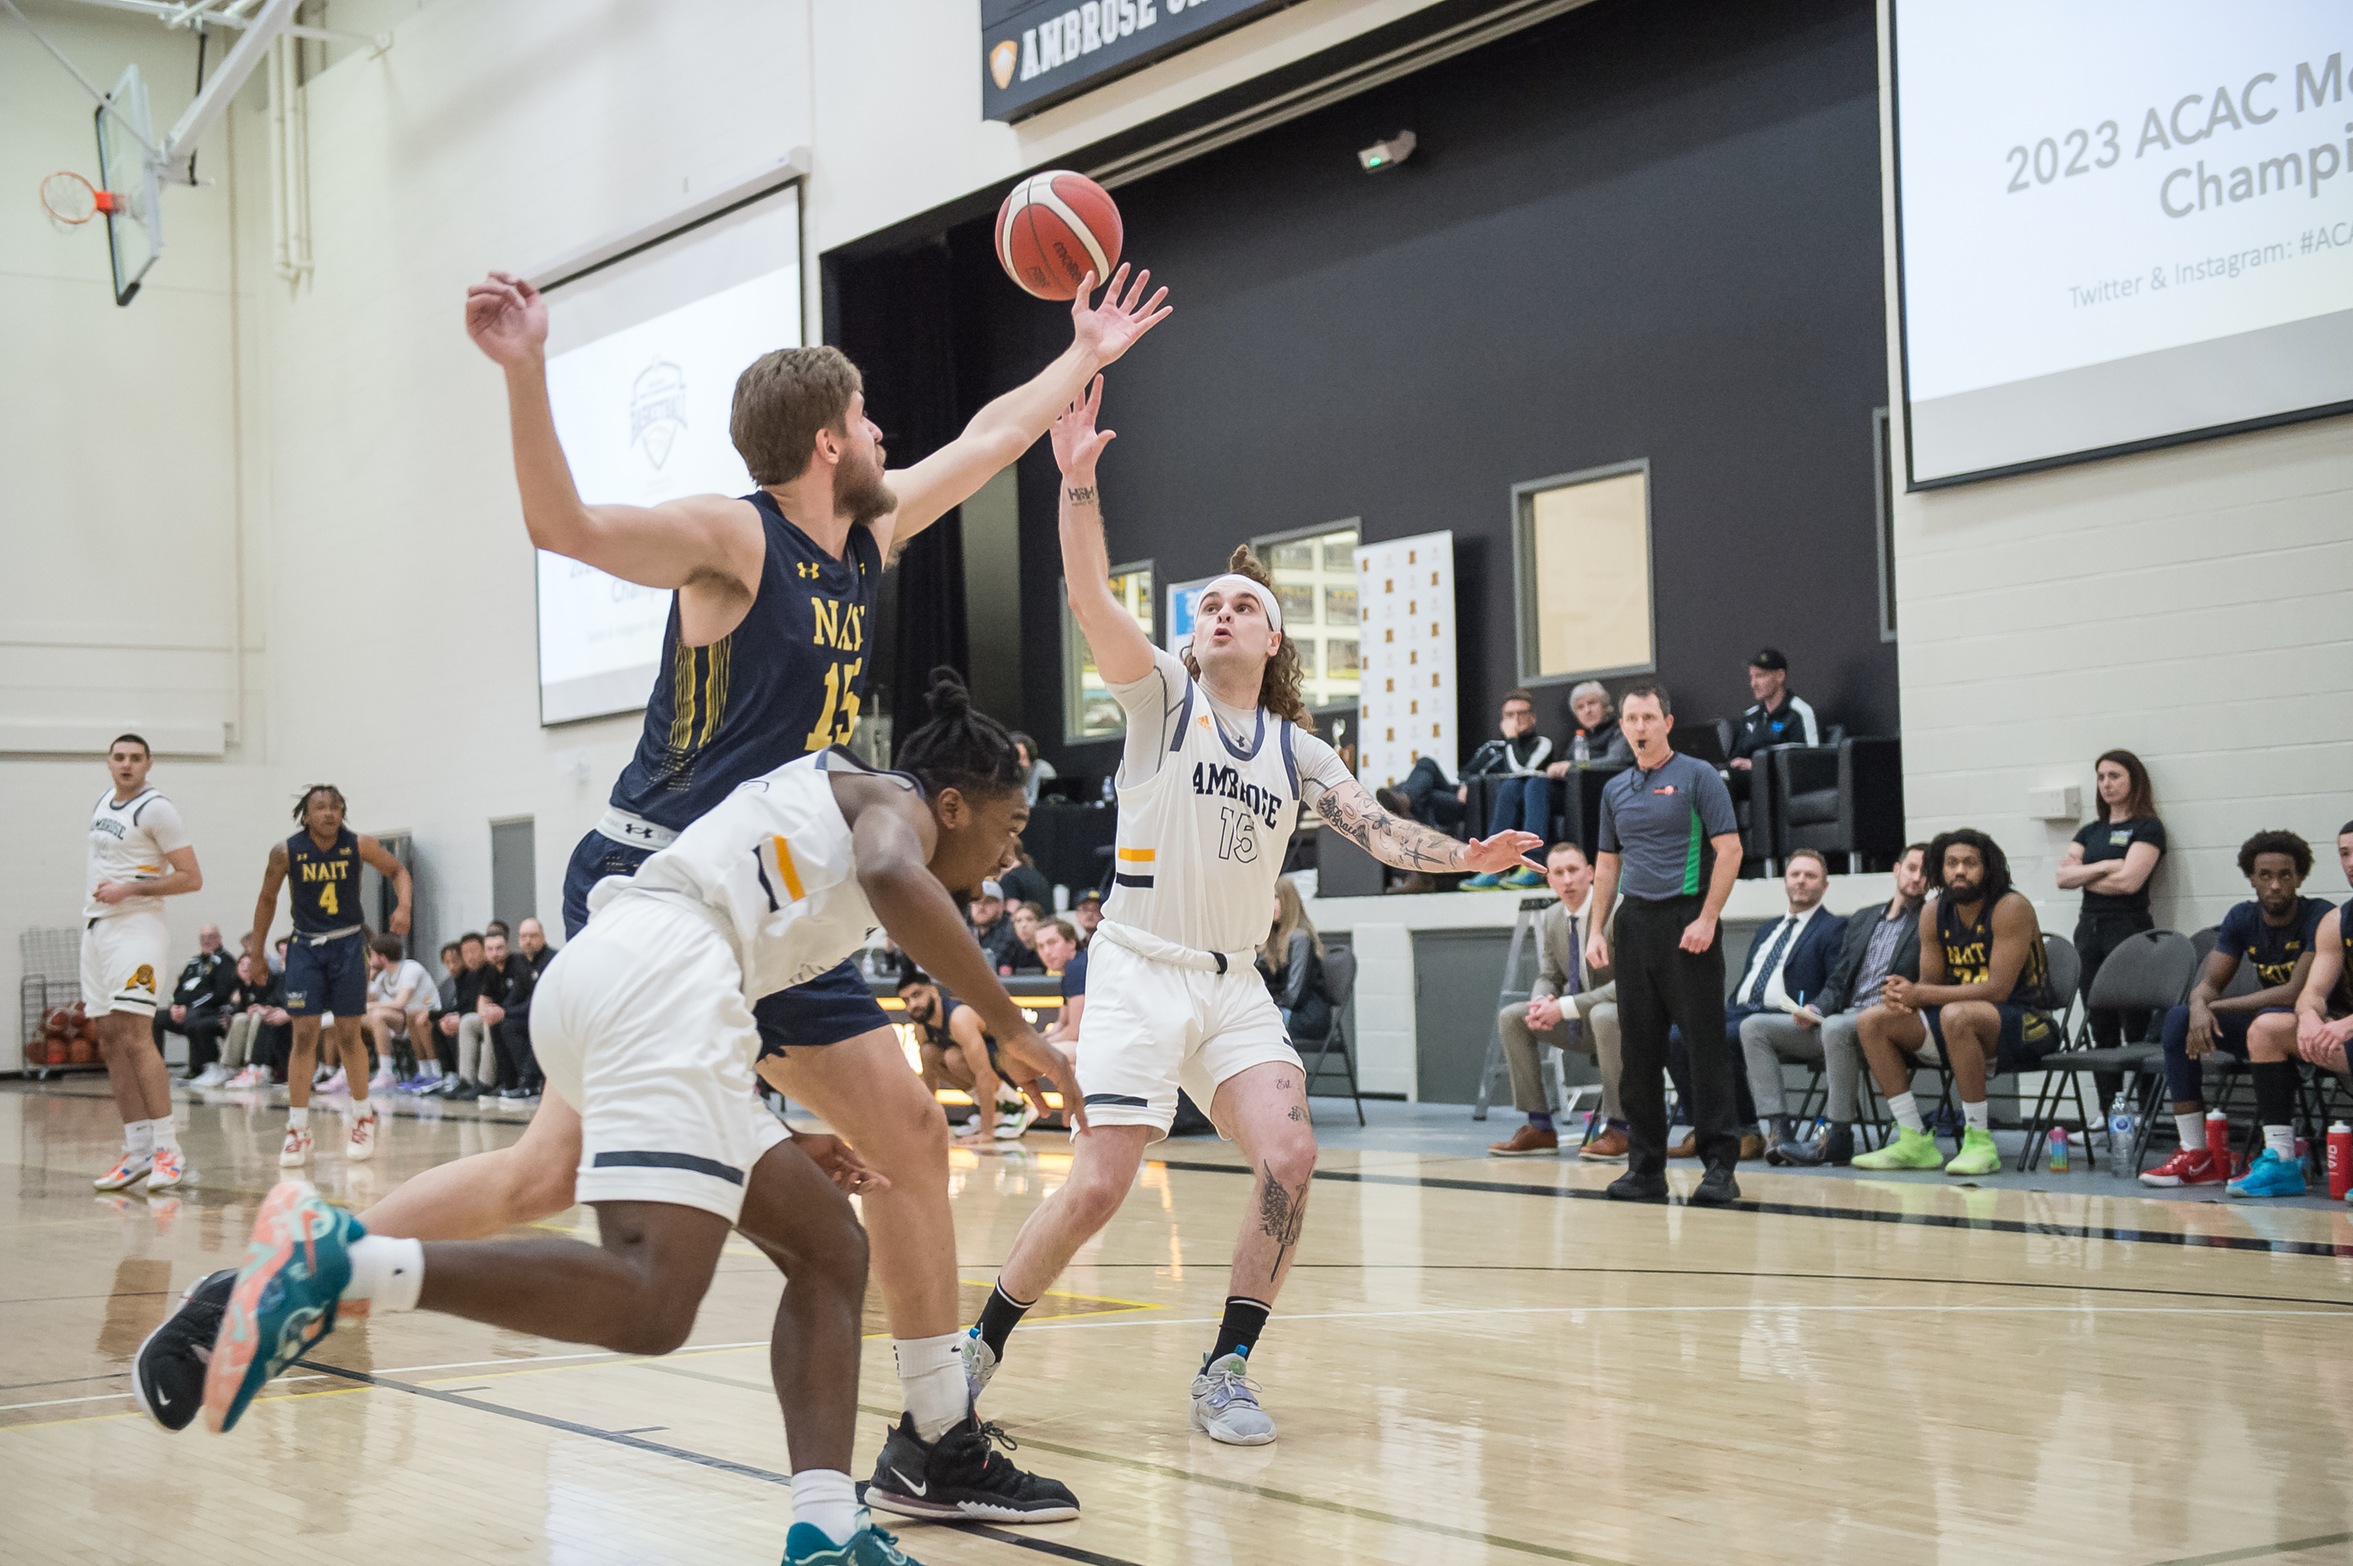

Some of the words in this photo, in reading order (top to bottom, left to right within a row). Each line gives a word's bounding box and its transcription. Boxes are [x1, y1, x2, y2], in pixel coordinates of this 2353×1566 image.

[1020, 0, 1157, 82] AMBROSE
[2006, 120, 2121, 194] 2023
[2135, 72, 2279, 159] ACAC
[2295, 51, 2353, 113] M
[2069, 276, 2143, 309] Twitter
[2150, 266, 2167, 291] &
[2175, 239, 2293, 287] Instagram:
[2300, 221, 2353, 256] #AC
[804, 657, 862, 750] 15
[302, 860, 349, 882] NAIT
[1218, 806, 1258, 863] 15
[318, 881, 339, 916] 4
